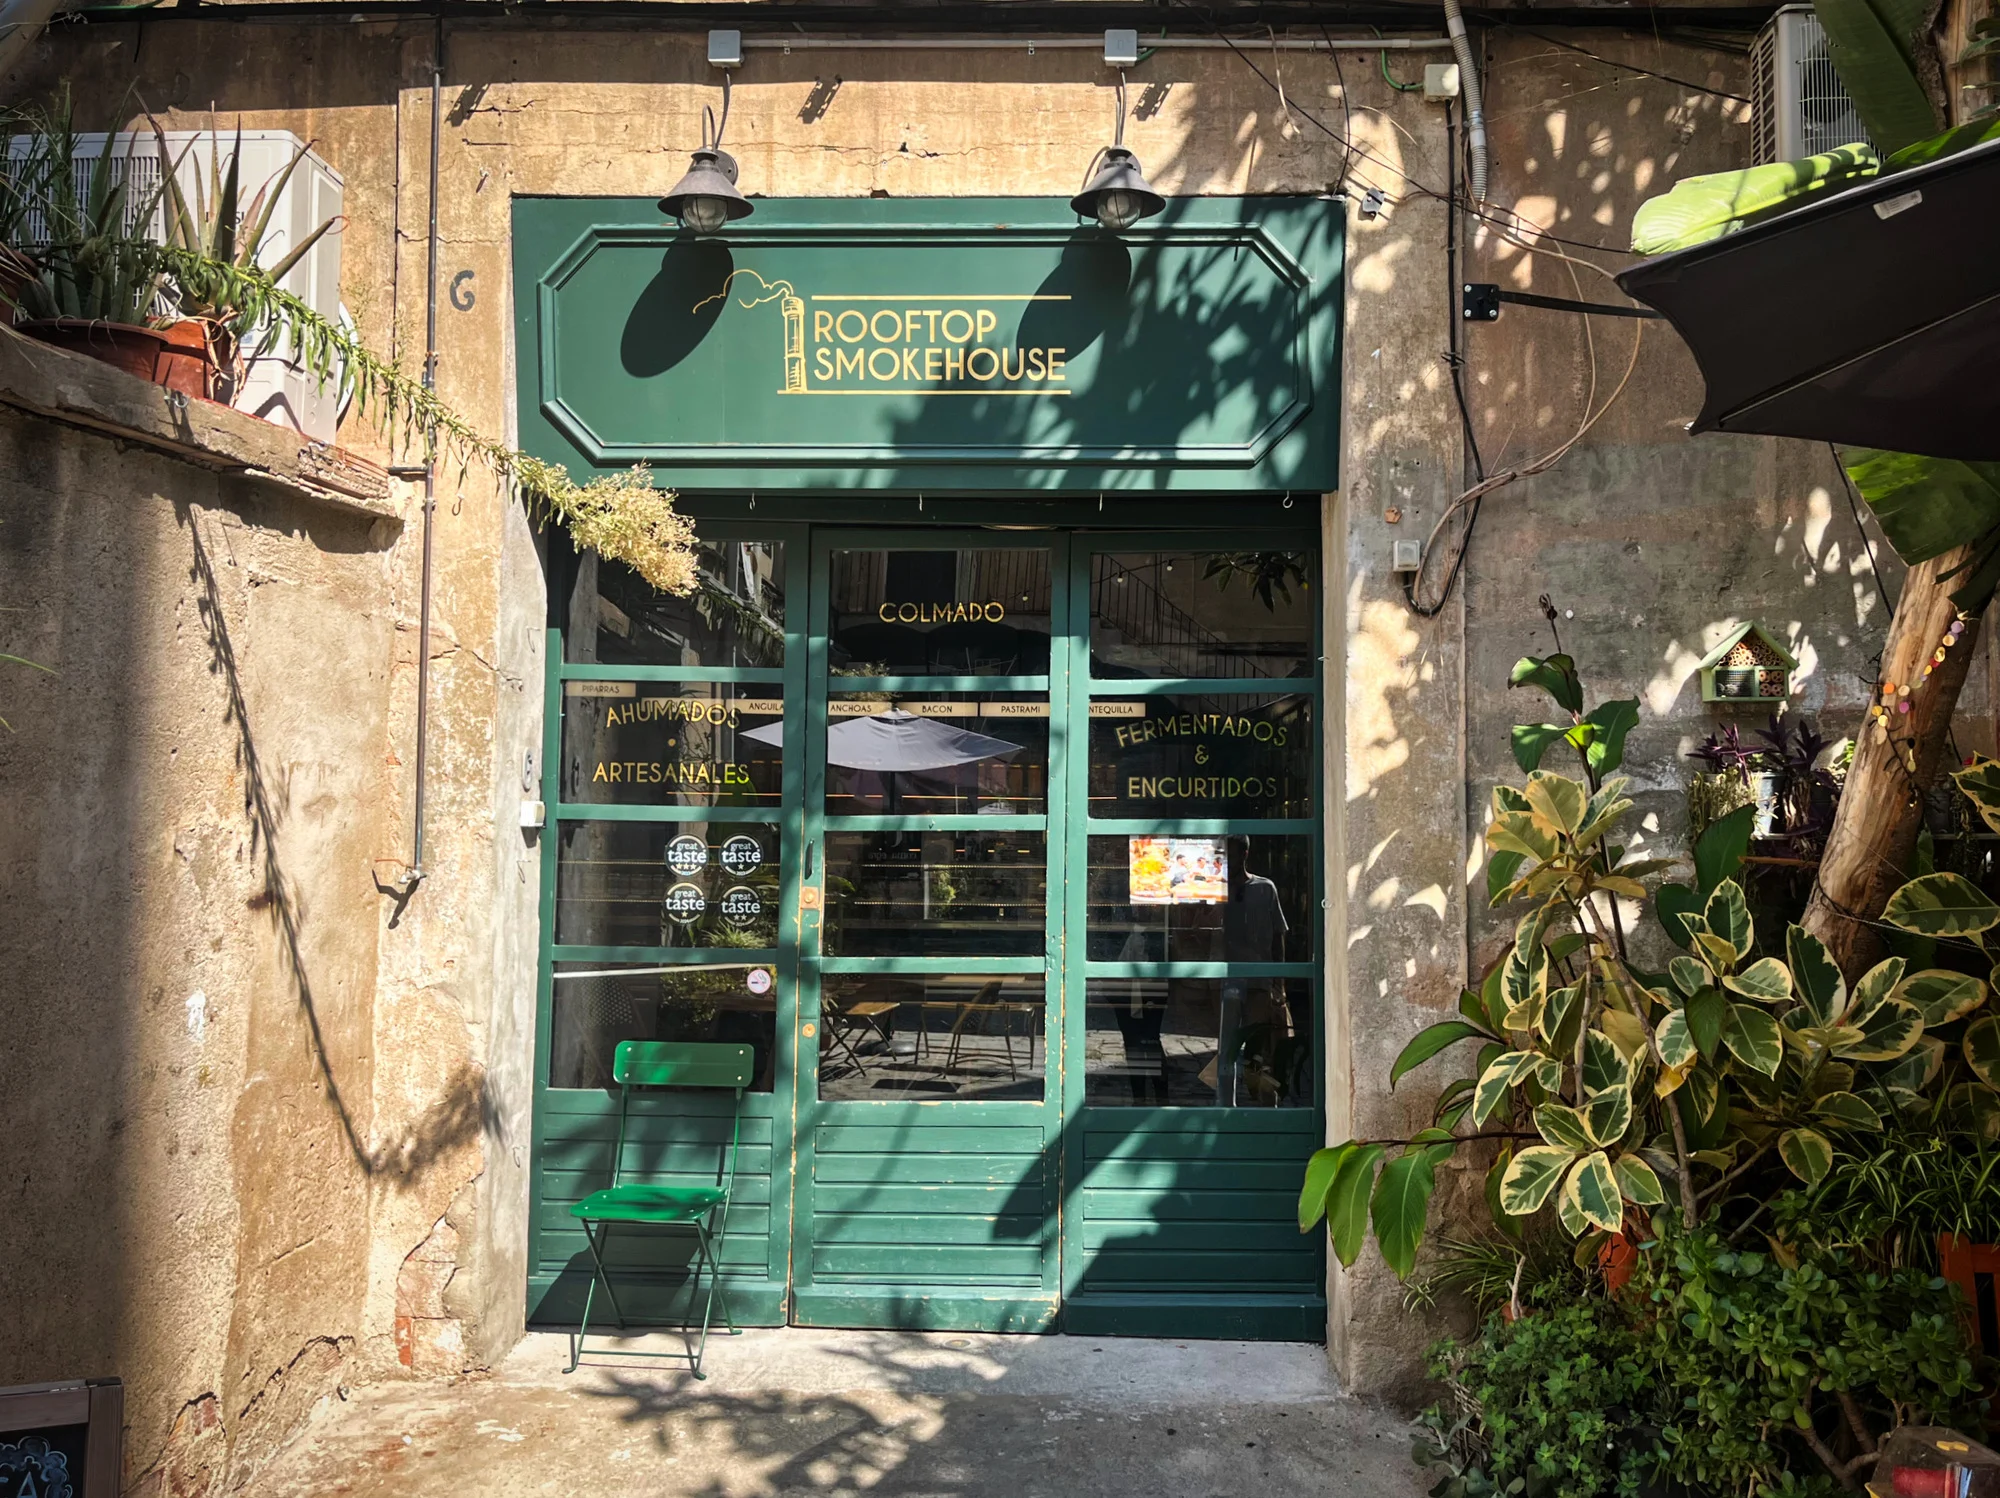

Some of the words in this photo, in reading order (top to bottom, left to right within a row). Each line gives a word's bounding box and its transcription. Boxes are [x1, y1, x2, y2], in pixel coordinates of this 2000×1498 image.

[450, 270, 475, 311] G
[814, 309, 997, 343] ROOFTOP
[813, 347, 1066, 381] SMOKEHOUSE
[879, 602, 1005, 623] COLMADO
[582, 685, 620, 694] PIPARRAS
[830, 702, 872, 713] ANCHOAS
[922, 705, 953, 714] BACON
[1001, 705, 1041, 714] PASTRAMI
[606, 700, 741, 729] AHUMADOS
[1114, 714, 1288, 748] FERMENTADOS
[1194, 744, 1209, 765] &
[592, 761, 750, 785] ARTESANALES
[1128, 777, 1277, 798] ENCURTIDOS
[676, 842, 698, 852] great
[730, 842, 752, 852] great
[667, 850, 707, 863] taste
[721, 850, 761, 863] taste
[674, 889, 697, 899] great
[730, 893, 753, 903] great
[665, 897, 705, 911] taste
[721, 901, 761, 914] taste
